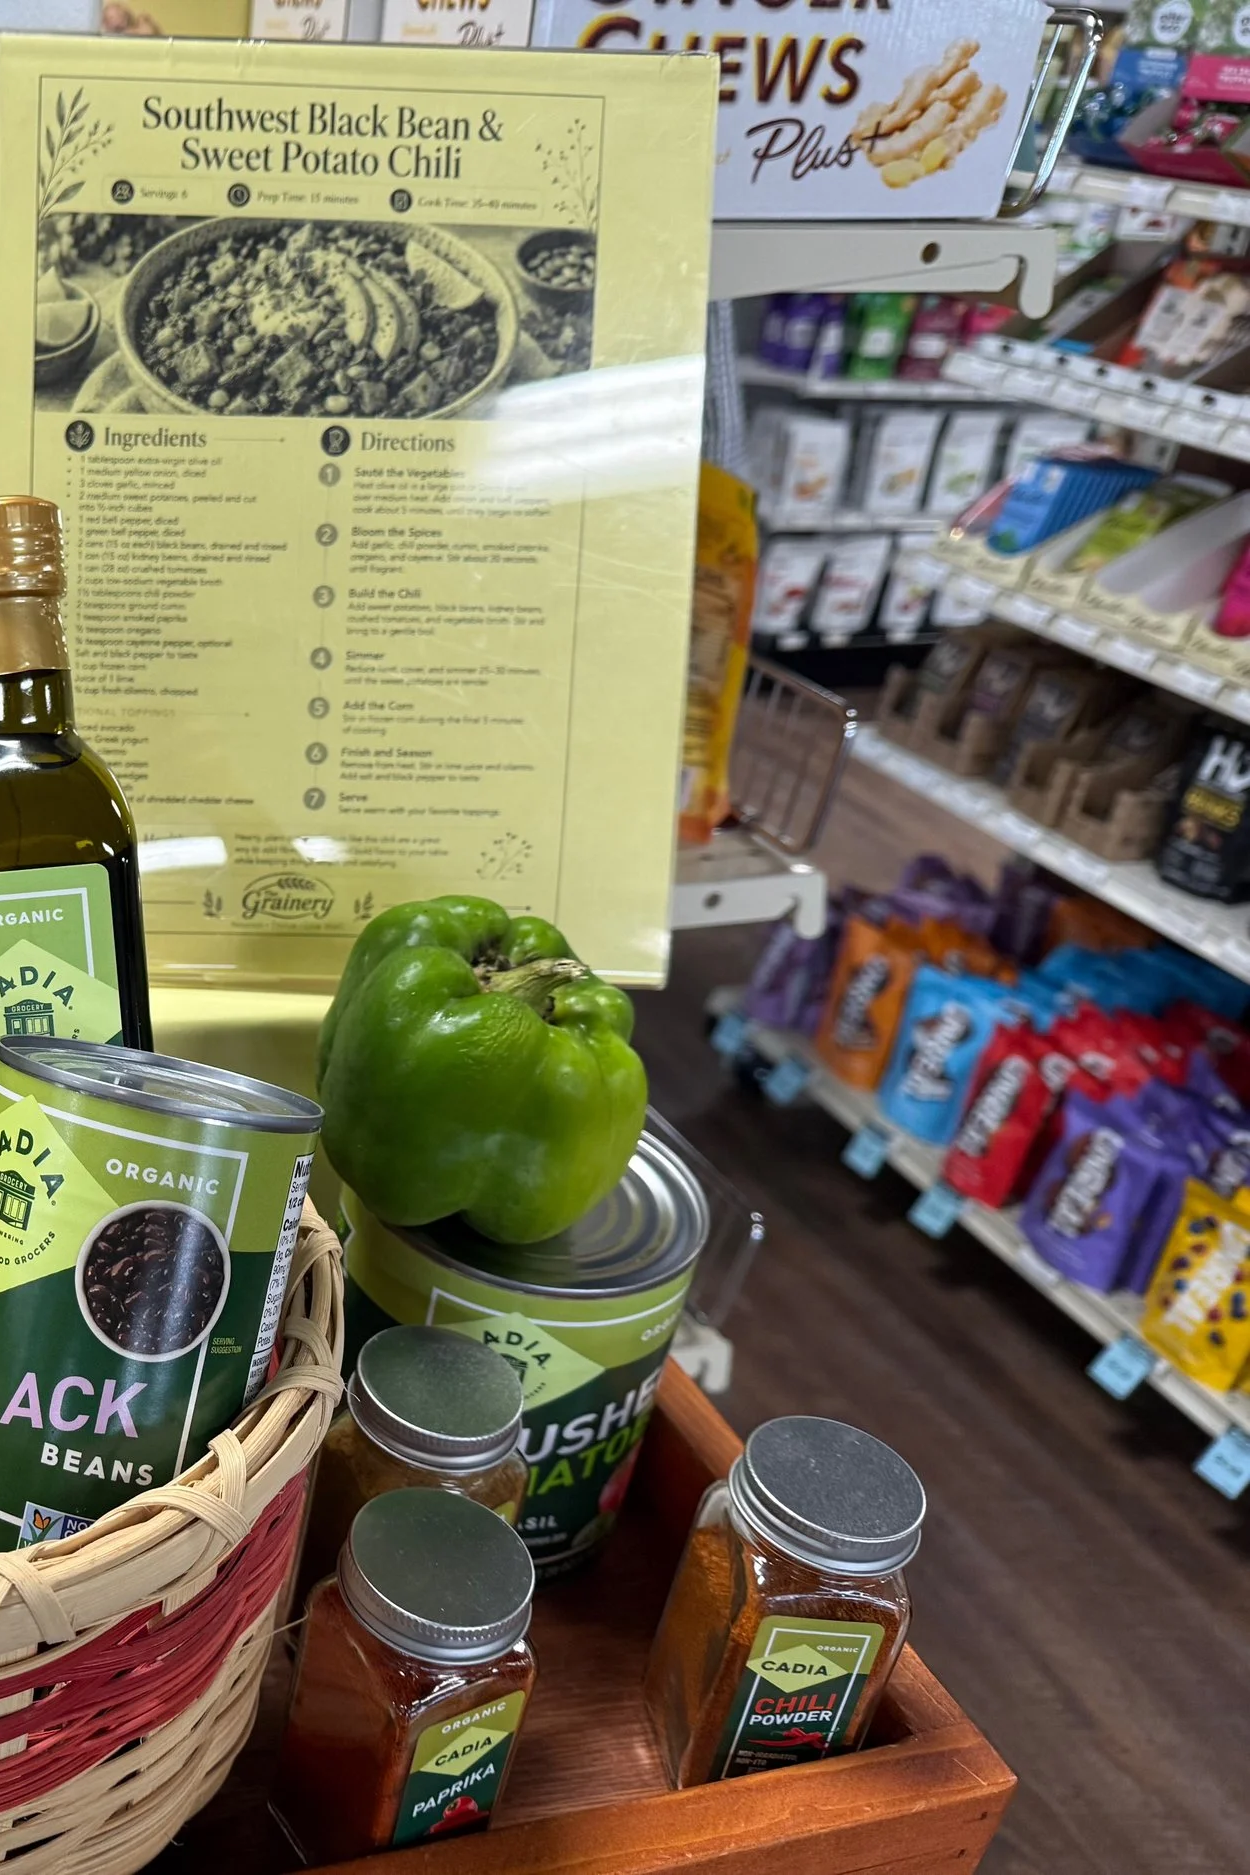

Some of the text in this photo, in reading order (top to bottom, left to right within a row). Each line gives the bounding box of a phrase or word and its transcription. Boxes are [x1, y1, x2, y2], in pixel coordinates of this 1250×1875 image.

[142, 96, 504, 142] Southwest Black Bean &
[180, 136, 462, 179] Sweet Potato Chili
[257, 190, 279, 204] Prep
[324, 193, 360, 205] minutes
[417, 196, 442, 209] Cook
[501, 199, 538, 212] minutes
[104, 427, 208, 451] Ingredients
[361, 431, 456, 453] Directions
[87, 468, 121, 477] medium
[123, 469, 150, 479] yellow
[182, 468, 207, 478] diced
[386, 467, 404, 478] the
[87, 493, 121, 501] medium
[123, 494, 147, 502] sweet
[225, 494, 242, 503] and
[351, 526, 443, 539] Bloom the Spices
[348, 588, 421, 599] Build the Chili
[343, 700, 414, 711] Add the Corn
[341, 746, 433, 759] Finish and Season
[338, 791, 368, 802] Serve
[241, 889, 336, 920] Grainery
[10, 1003, 45, 1013] GROCERY
[0, 1174, 28, 1192] GROCERY
[106, 1157, 220, 1196] ORGANIC
[14, 1231, 57, 1266] GROCERS
[211, 1345, 242, 1354] SUGGESTION
[212, 1337, 235, 1345] SERVING
[483, 1329, 552, 1367] ADIA
[40, 1442, 153, 1486] BEANS
[816, 1645, 860, 1654] ORGANIC
[760, 1660, 830, 1677] CADIA
[753, 1693, 837, 1715] CHILI
[441, 1701, 507, 1735] ORGANIC
[749, 1710, 833, 1727] POWDER
[434, 1735, 493, 1768] CADIA
[411, 1763, 496, 1818] PAPRIKA
